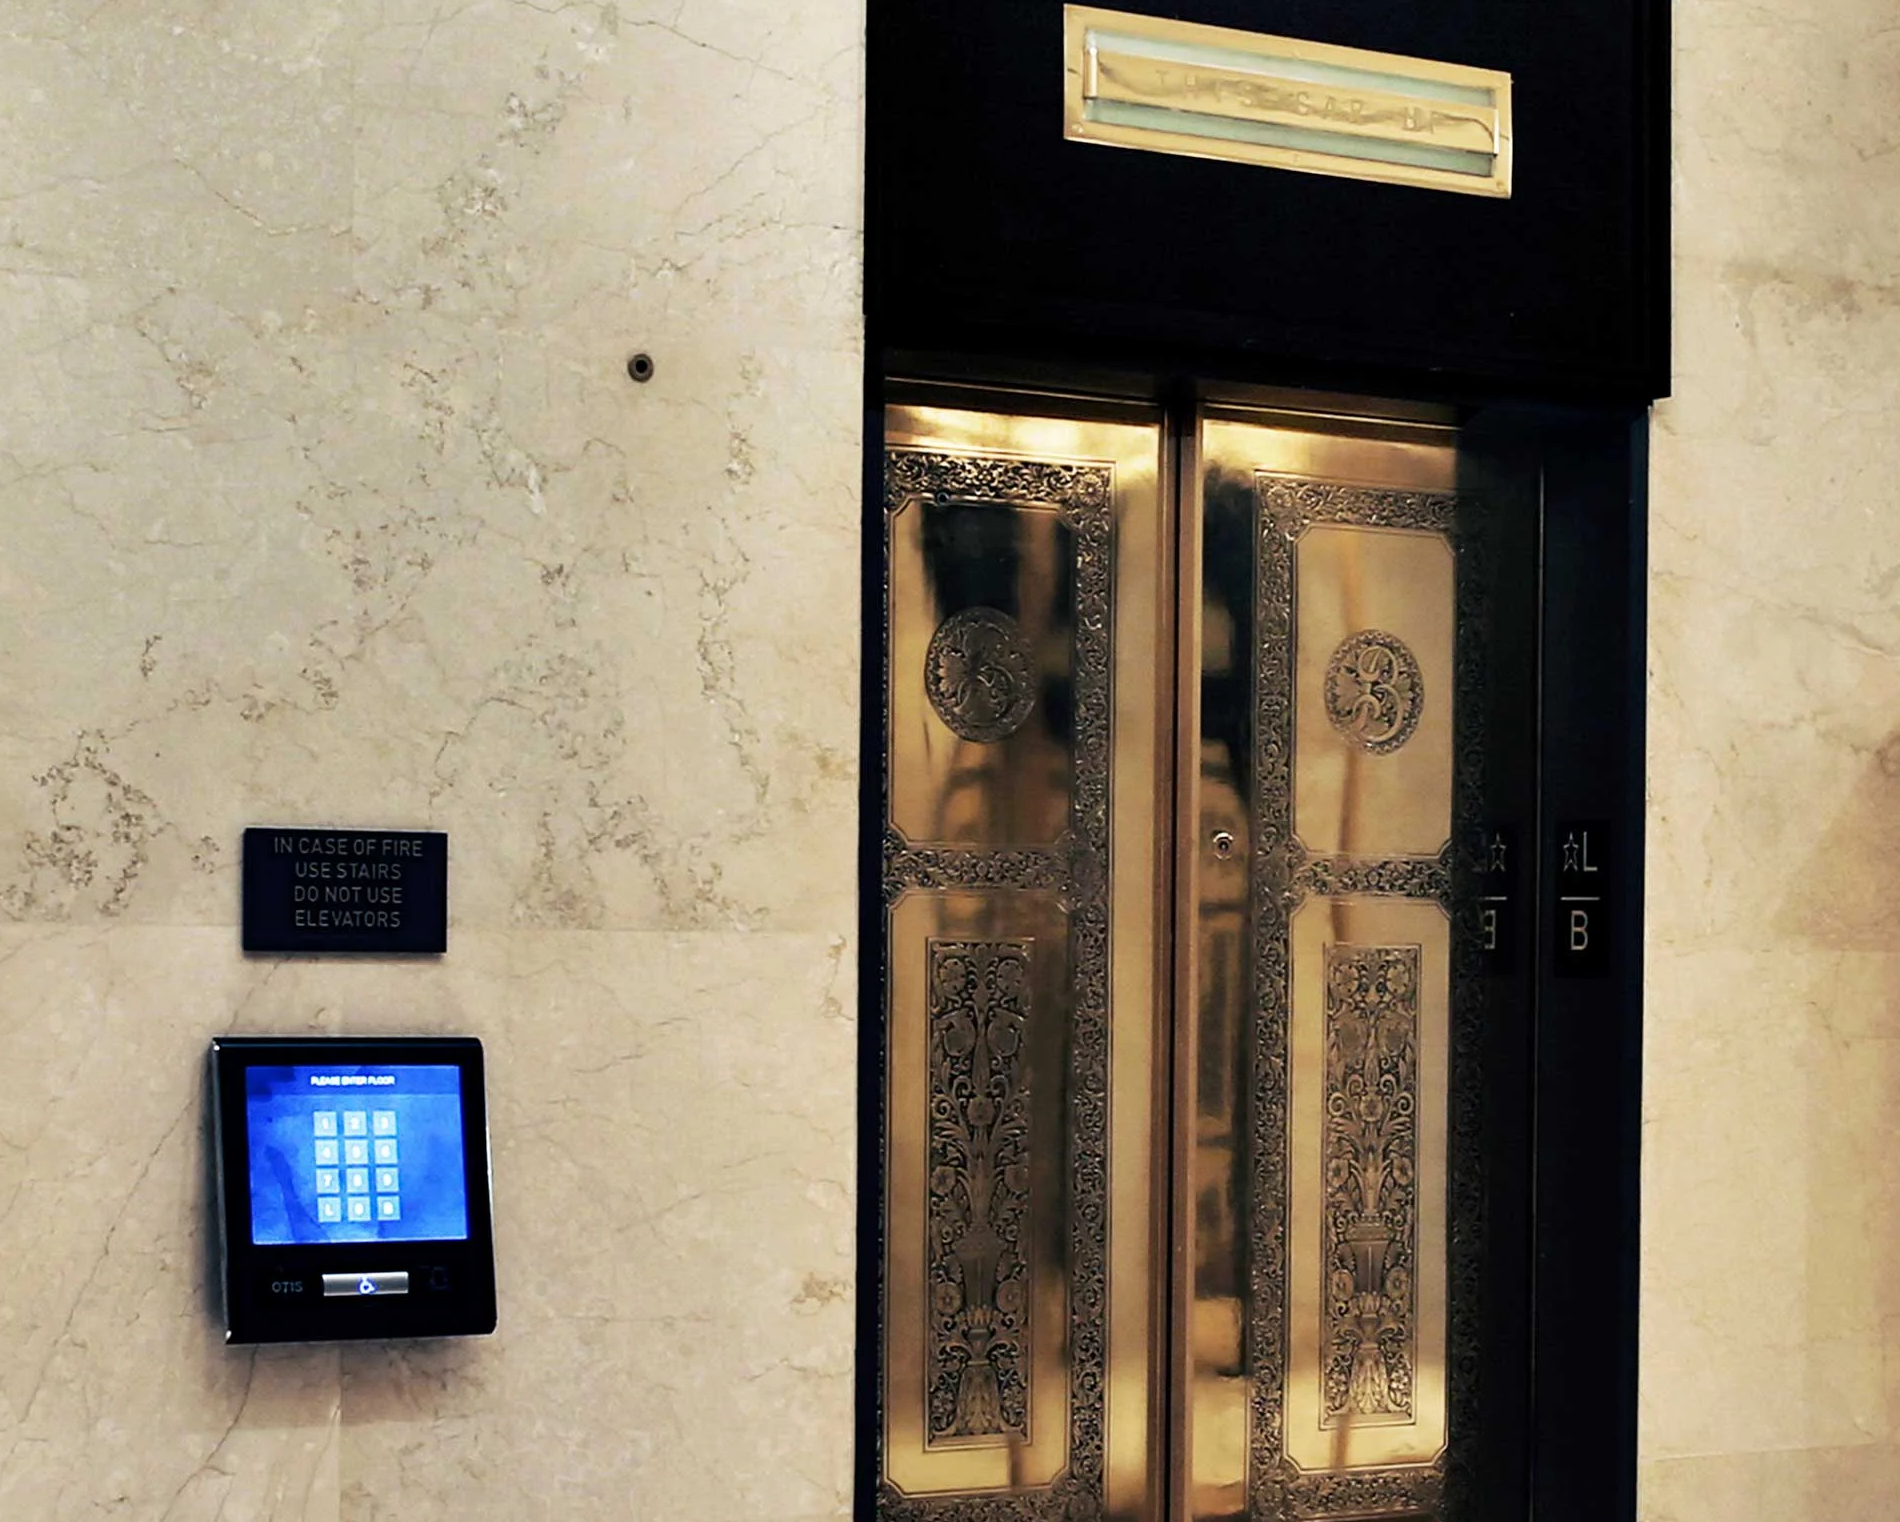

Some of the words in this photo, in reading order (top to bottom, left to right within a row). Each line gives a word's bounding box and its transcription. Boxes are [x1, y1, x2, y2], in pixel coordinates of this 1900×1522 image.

[273, 837, 293, 854] IN
[298, 838, 349, 855] CASE
[353, 839, 377, 856] OF
[382, 840, 423, 857] FIRE
[1583, 832, 1598, 872] L
[295, 862, 332, 878] USE
[336, 863, 402, 880] STAIRS
[294, 886, 319, 902] DO
[325, 887, 362, 903] NOT
[367, 887, 403, 904] USE
[295, 910, 401, 928] ELEVATORS
[1570, 910, 1589, 951] B
[271, 1280, 303, 1294] OTIS
